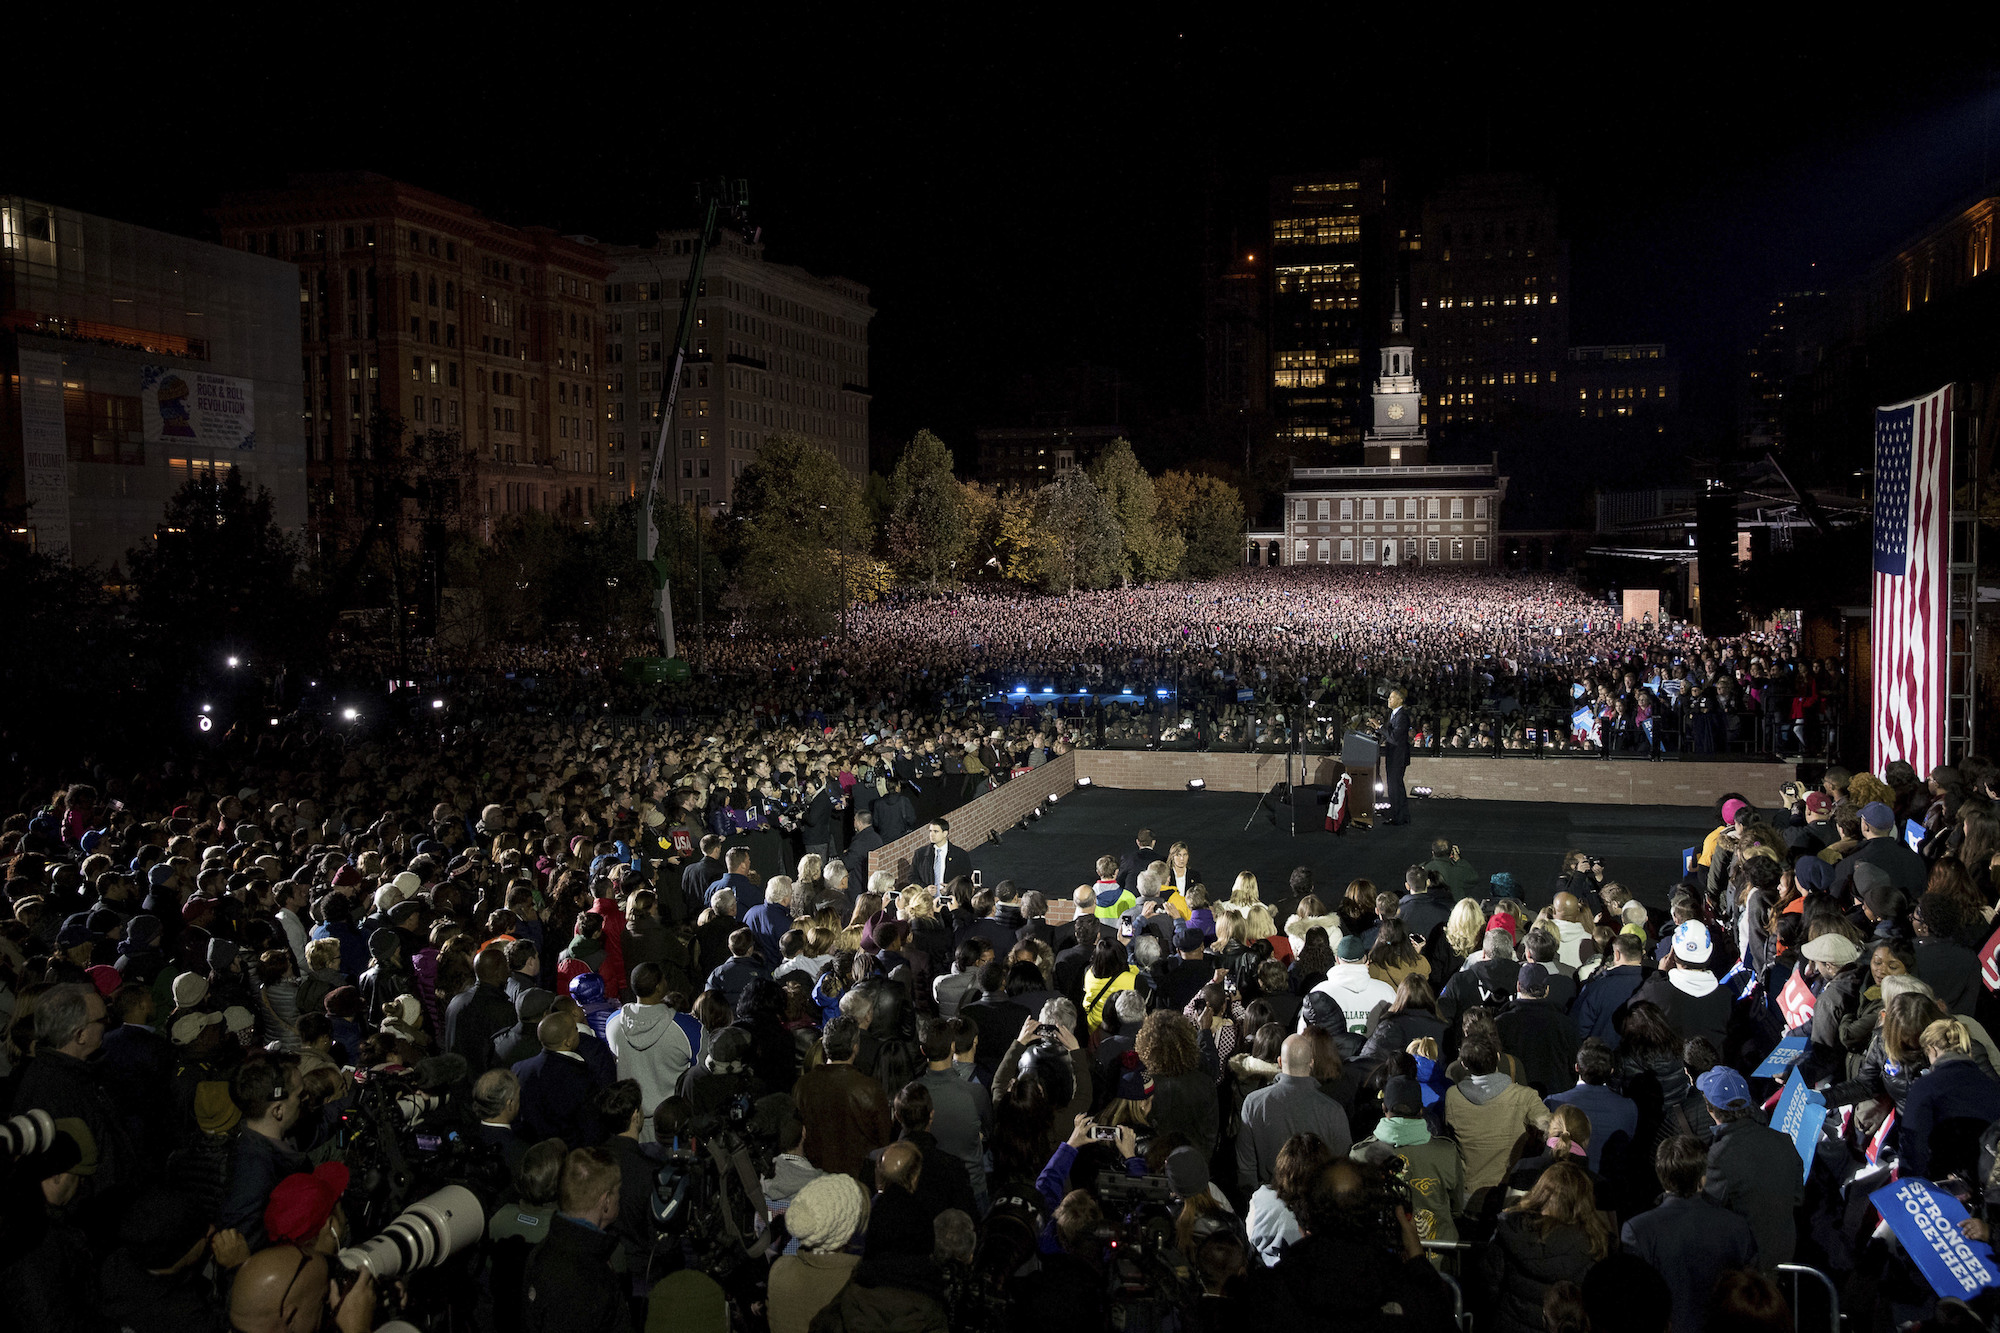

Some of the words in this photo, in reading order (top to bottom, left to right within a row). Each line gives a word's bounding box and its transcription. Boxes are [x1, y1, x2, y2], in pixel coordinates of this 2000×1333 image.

[197, 383, 217, 397] ROCK
[219, 386, 225, 398] &
[227, 386, 244, 401] ROLL
[198, 397, 245, 415] REVOLUTION
[27, 452, 65, 468] WELCOME!
[674, 835, 692, 850] USA
[1895, 1186, 1978, 1293] TOGETHER
[1907, 1181, 1993, 1286] STRONGER
